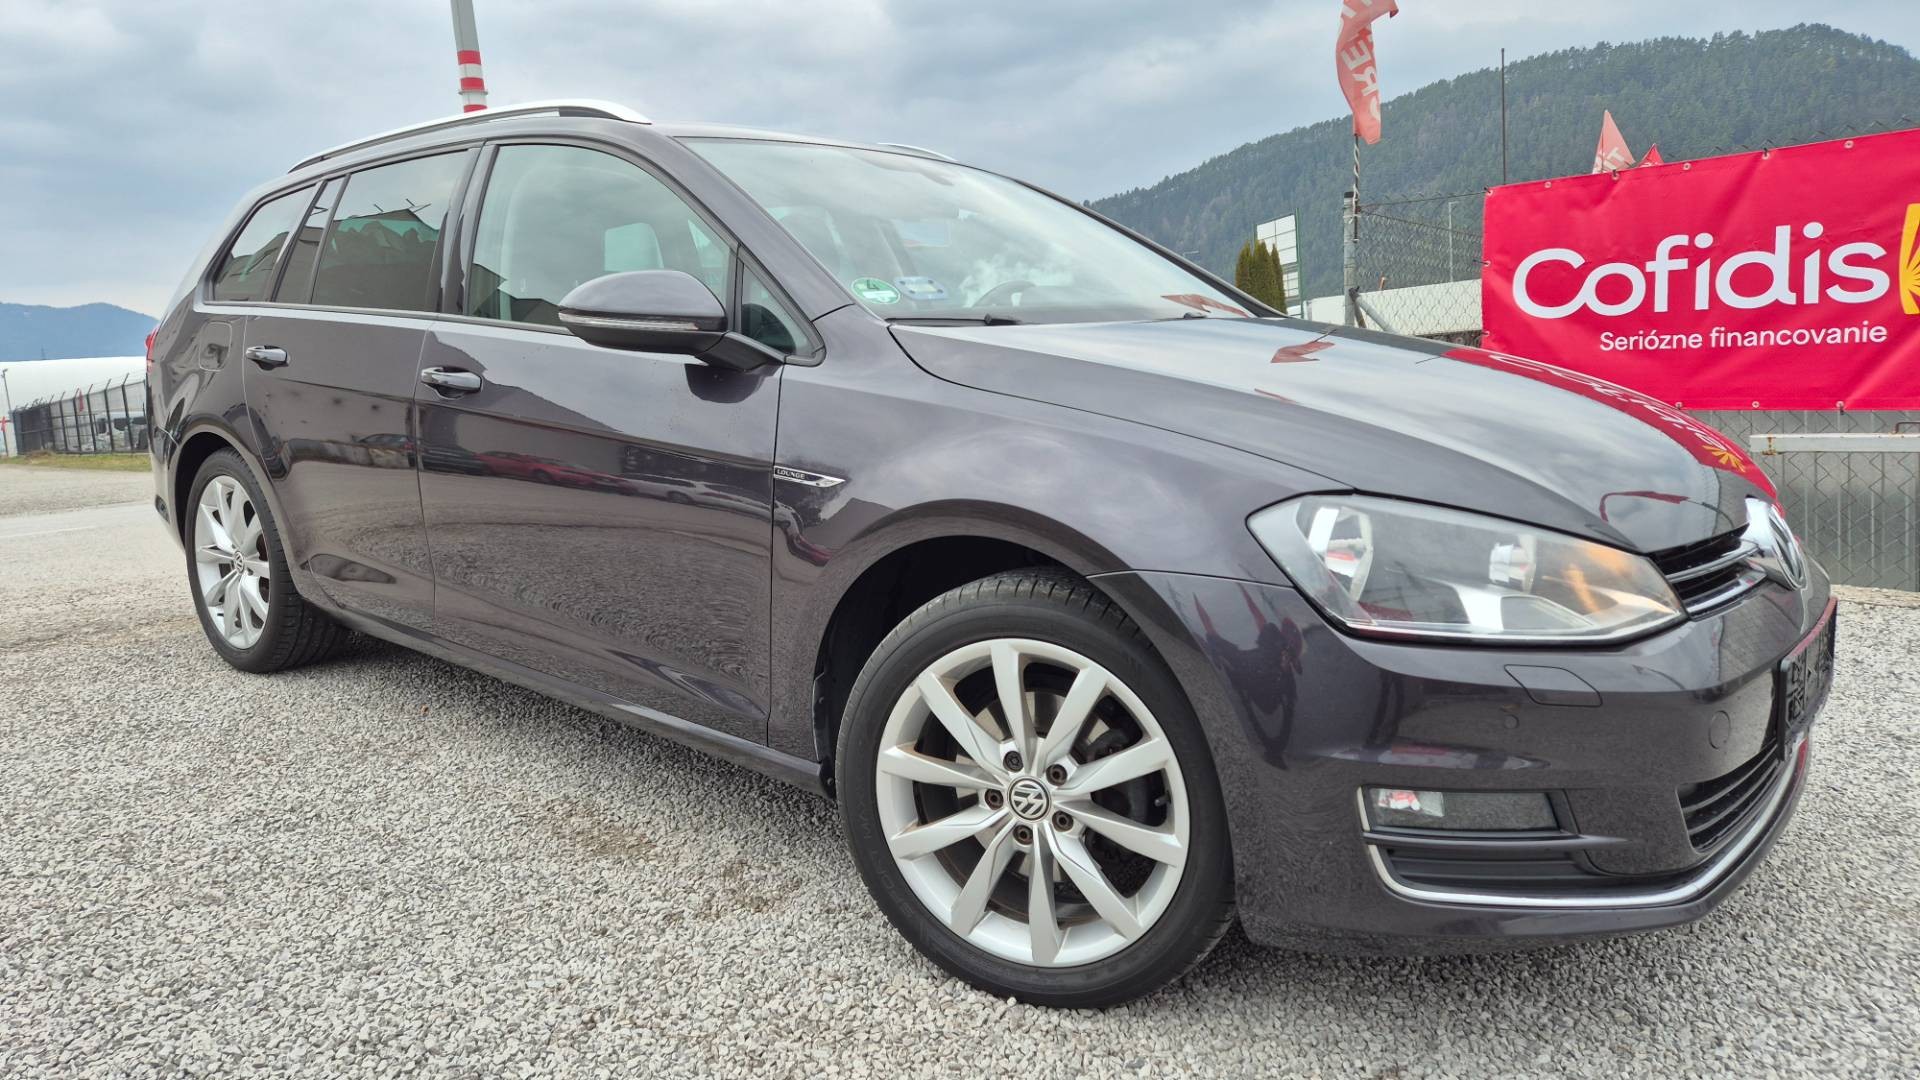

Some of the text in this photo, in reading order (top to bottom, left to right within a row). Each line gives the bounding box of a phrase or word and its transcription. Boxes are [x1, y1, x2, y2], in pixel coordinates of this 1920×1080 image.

[1513, 222, 1890, 318] Cofidis
[1600, 321, 1888, 351] Seriózne financovanie
[776, 469, 806, 479] LOUNGE
